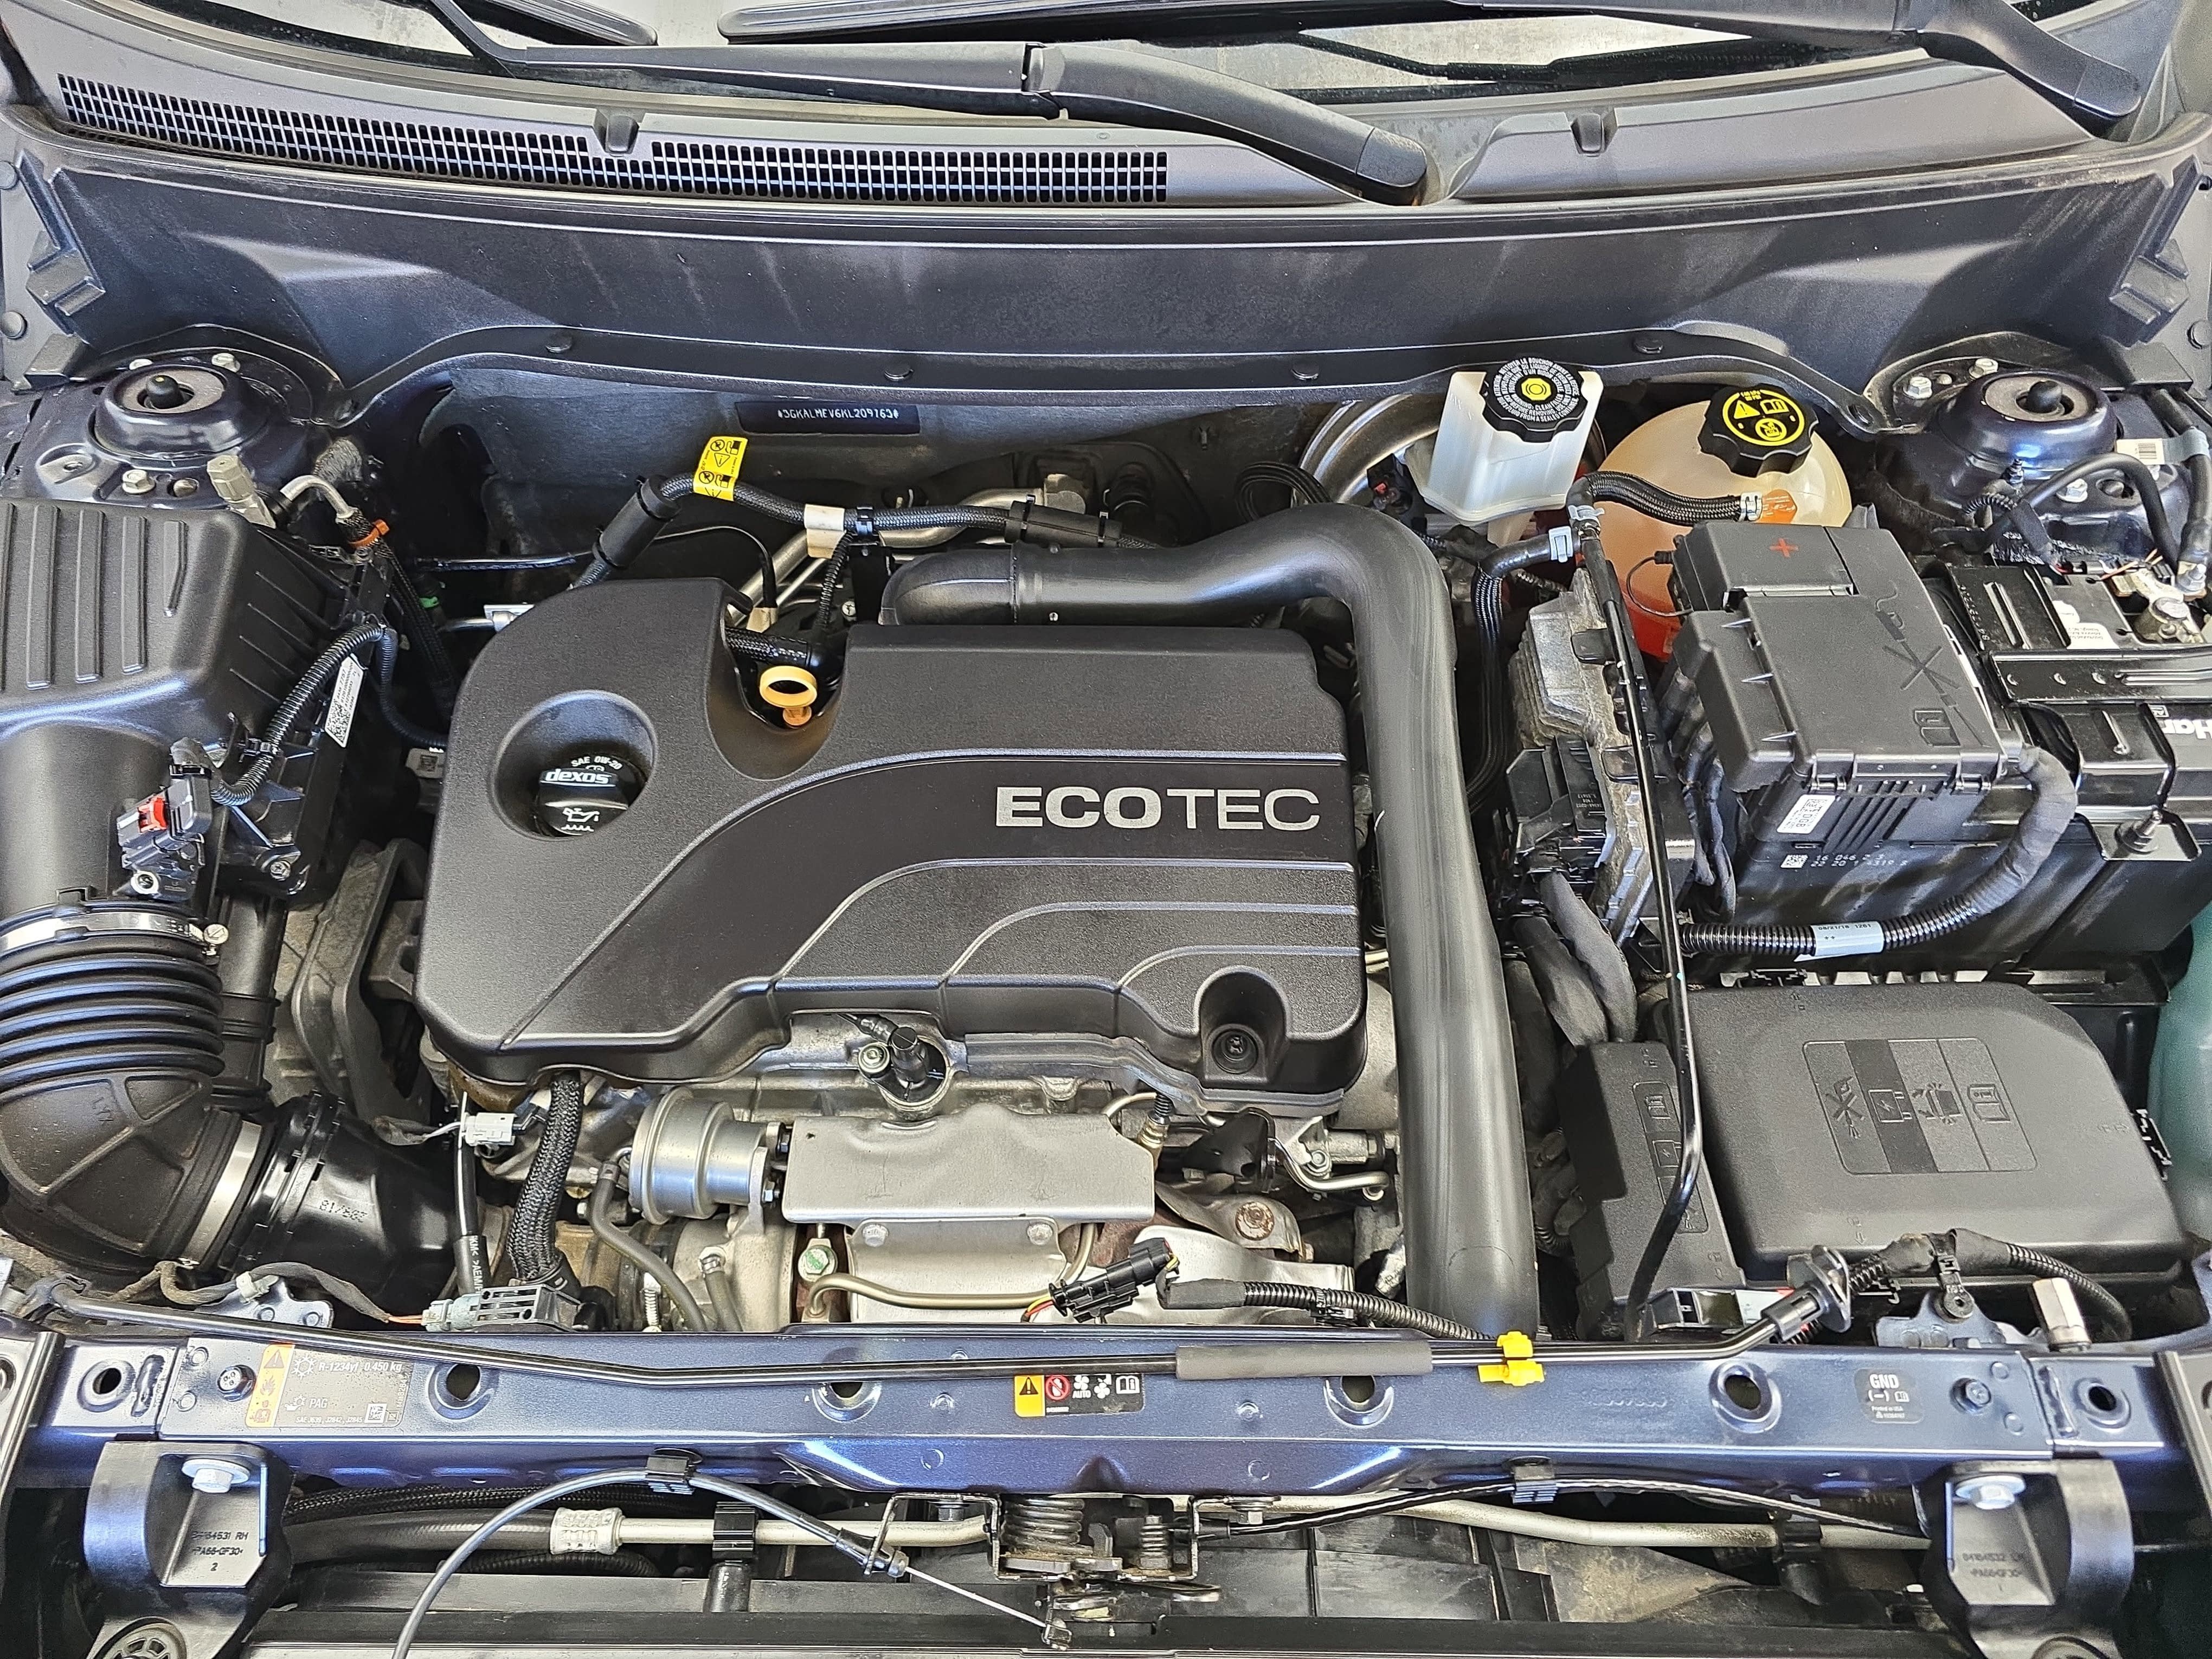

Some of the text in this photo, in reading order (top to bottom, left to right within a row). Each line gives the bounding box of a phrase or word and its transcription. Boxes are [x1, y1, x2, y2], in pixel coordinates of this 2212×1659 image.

[1528, 357, 1554, 366] BOUCHON
[1509, 401, 1529, 414] BEFORE
[1519, 412, 1535, 421] FROM
[1540, 413, 1561, 422] SEALED
[570, 755, 623, 770] SAE 0W-20
[545, 768, 612, 785] dexos
[996, 786, 1321, 831] ECOTEC
[318, 1361, 402, 1373] R-1234yf 0.450 kg
[1869, 1374, 1899, 1388] GND
[1072, 1390, 1091, 1398] AUTO
[308, 1398, 328, 1409] PAG
[235, 1532, 249, 1540] RH
[210, 1562, 218, 1571] 2
